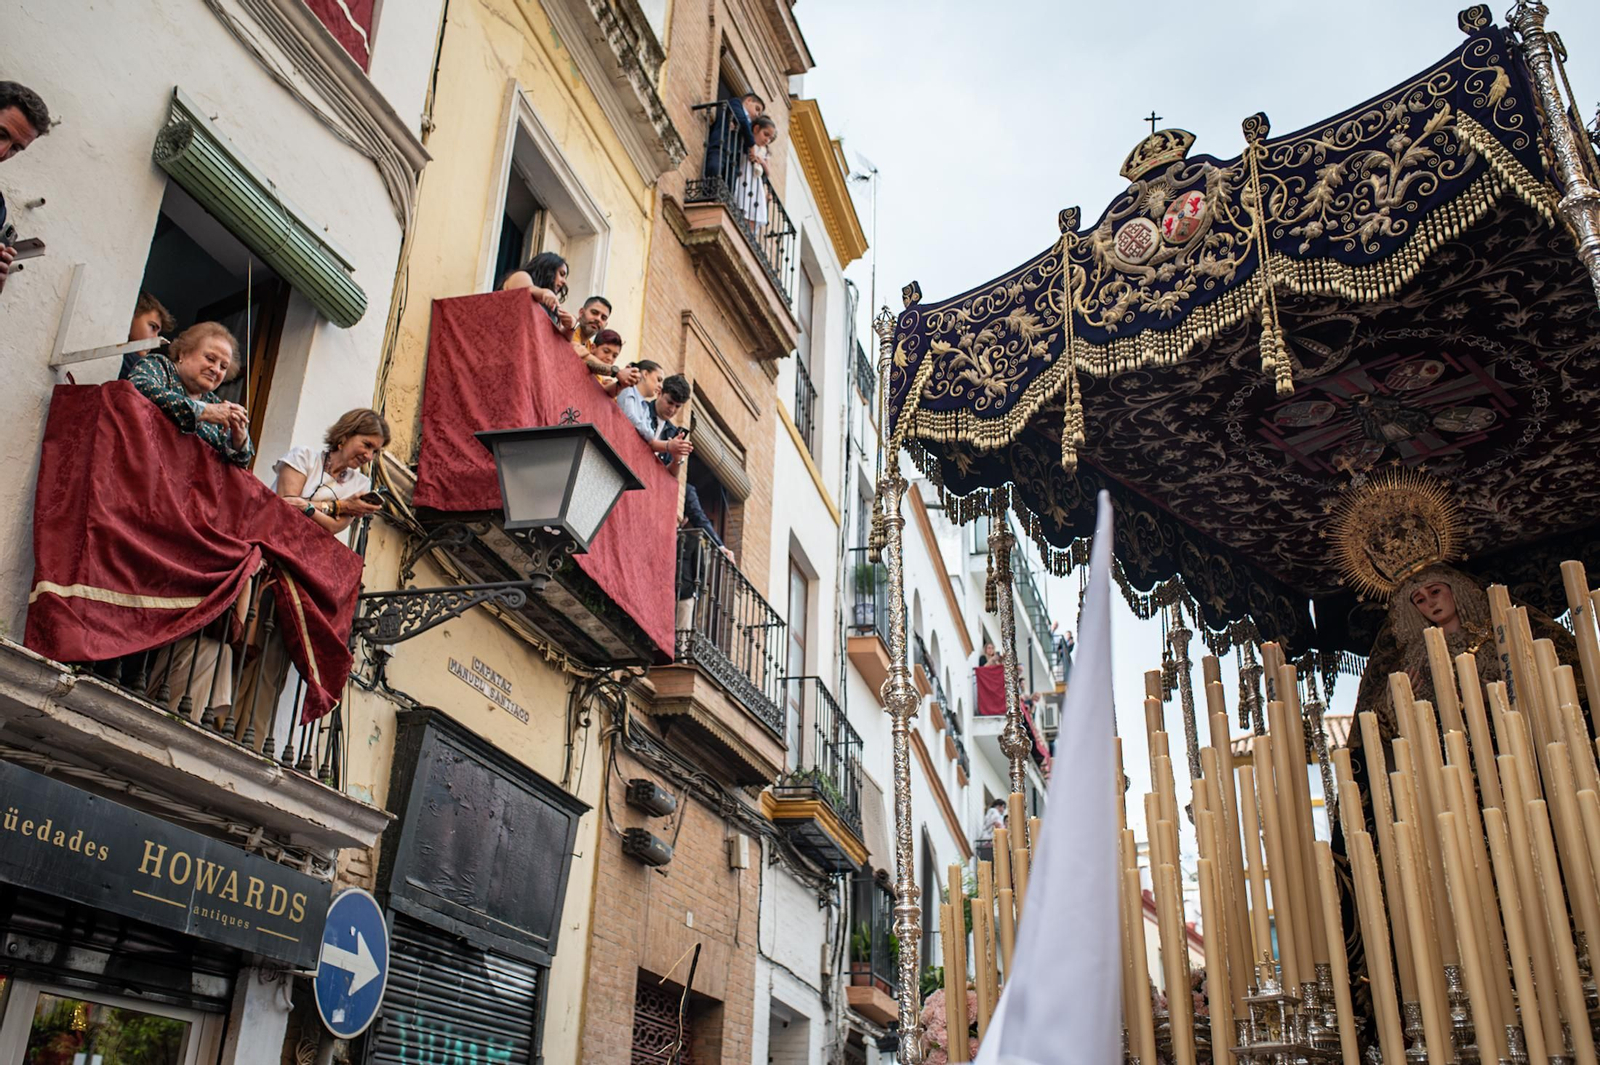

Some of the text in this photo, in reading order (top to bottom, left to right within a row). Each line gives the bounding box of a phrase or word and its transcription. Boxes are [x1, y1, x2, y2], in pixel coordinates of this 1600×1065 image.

[449, 658, 530, 723] MANUEL SANTIAGO
[473, 658, 513, 694] CAPATAZ
[0, 807, 109, 861] üedades
[138, 840, 307, 923] HOWARDS
[193, 904, 250, 930] antiques
